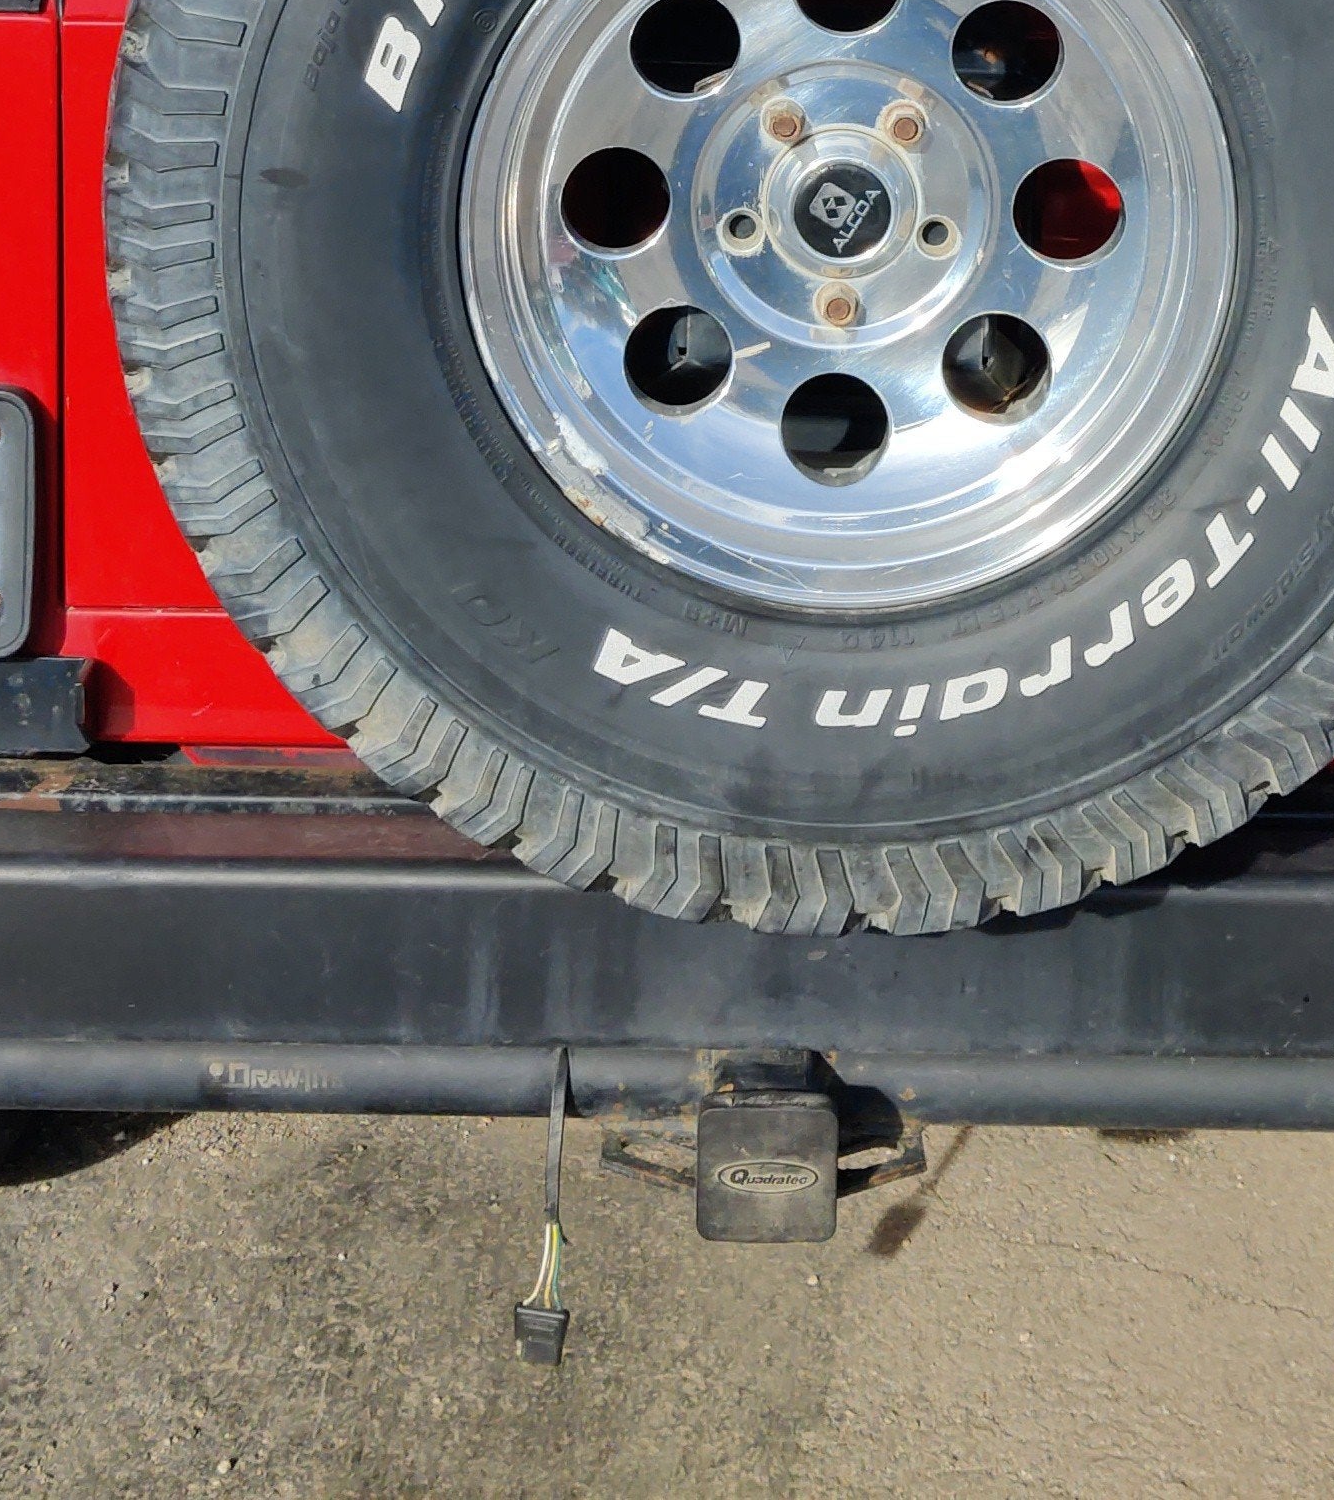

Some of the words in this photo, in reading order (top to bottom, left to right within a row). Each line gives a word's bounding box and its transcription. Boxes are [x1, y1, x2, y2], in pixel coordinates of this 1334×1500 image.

[831, 188, 881, 254] ALCOA
[593, 627, 770, 729] T/A
[730, 1167, 809, 1185] Quadratec
